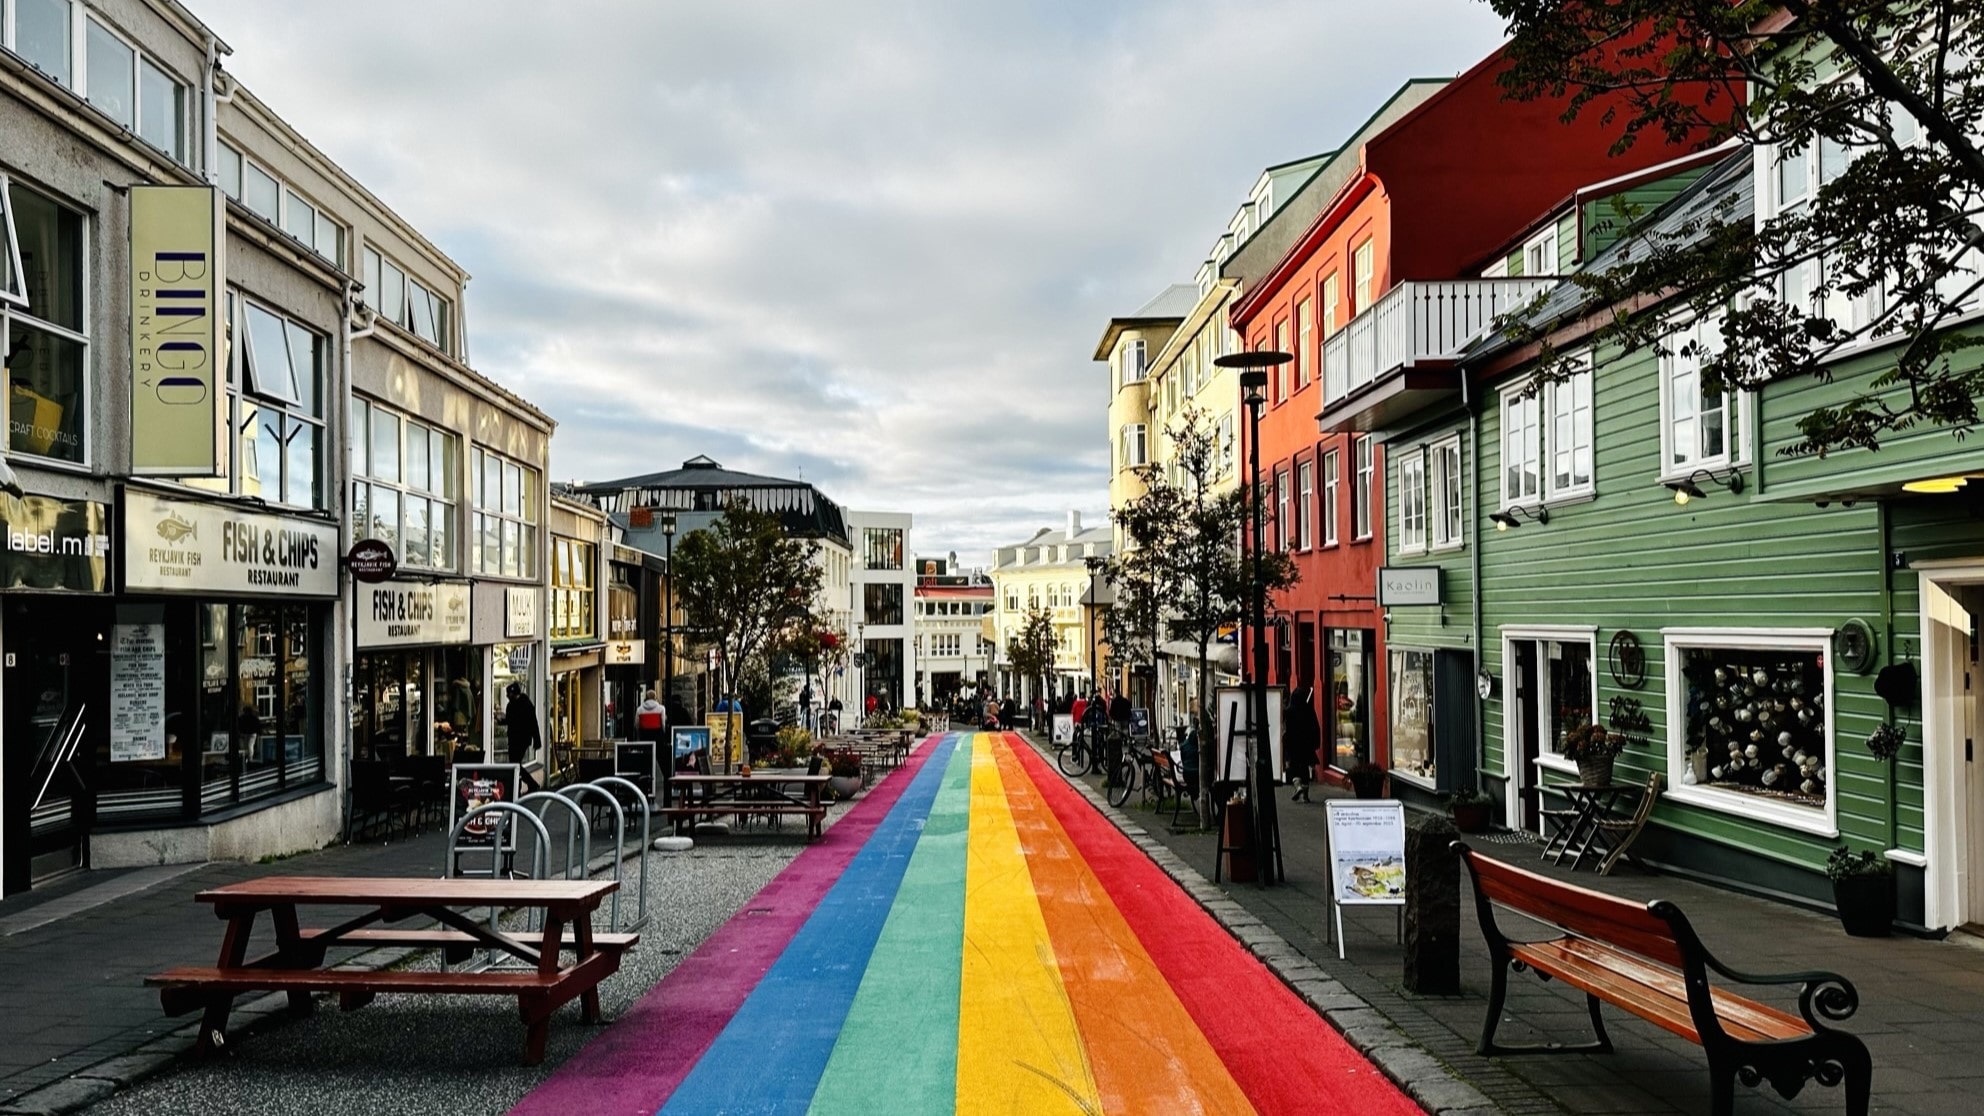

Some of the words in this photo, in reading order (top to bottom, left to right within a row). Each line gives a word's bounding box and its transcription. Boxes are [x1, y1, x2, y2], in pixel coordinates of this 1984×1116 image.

[139, 271, 151, 388] DRINKERY
[155, 252, 207, 405] BINGO
[9, 419, 35, 437] CRAFT
[36, 426, 78, 447] COCKTAILS
[223, 520, 259, 565] FISH
[262, 529, 276, 566] &
[278, 529, 318, 569] CHIPS
[149, 547, 185, 564] REYKJAVIK
[187, 551, 202, 565] FISH
[1895, 553, 1900, 566] 5
[159, 566, 191, 577] RESTAURANT
[247, 568, 300, 587] RESTAURANT
[1386, 579, 1432, 591] Kaolin
[373, 589, 395, 621] FISH
[397, 592, 406, 621] &
[407, 591, 433, 621] CHIPS
[388, 624, 421, 637] RESTAURANT
[8, 655, 14, 666] 8
